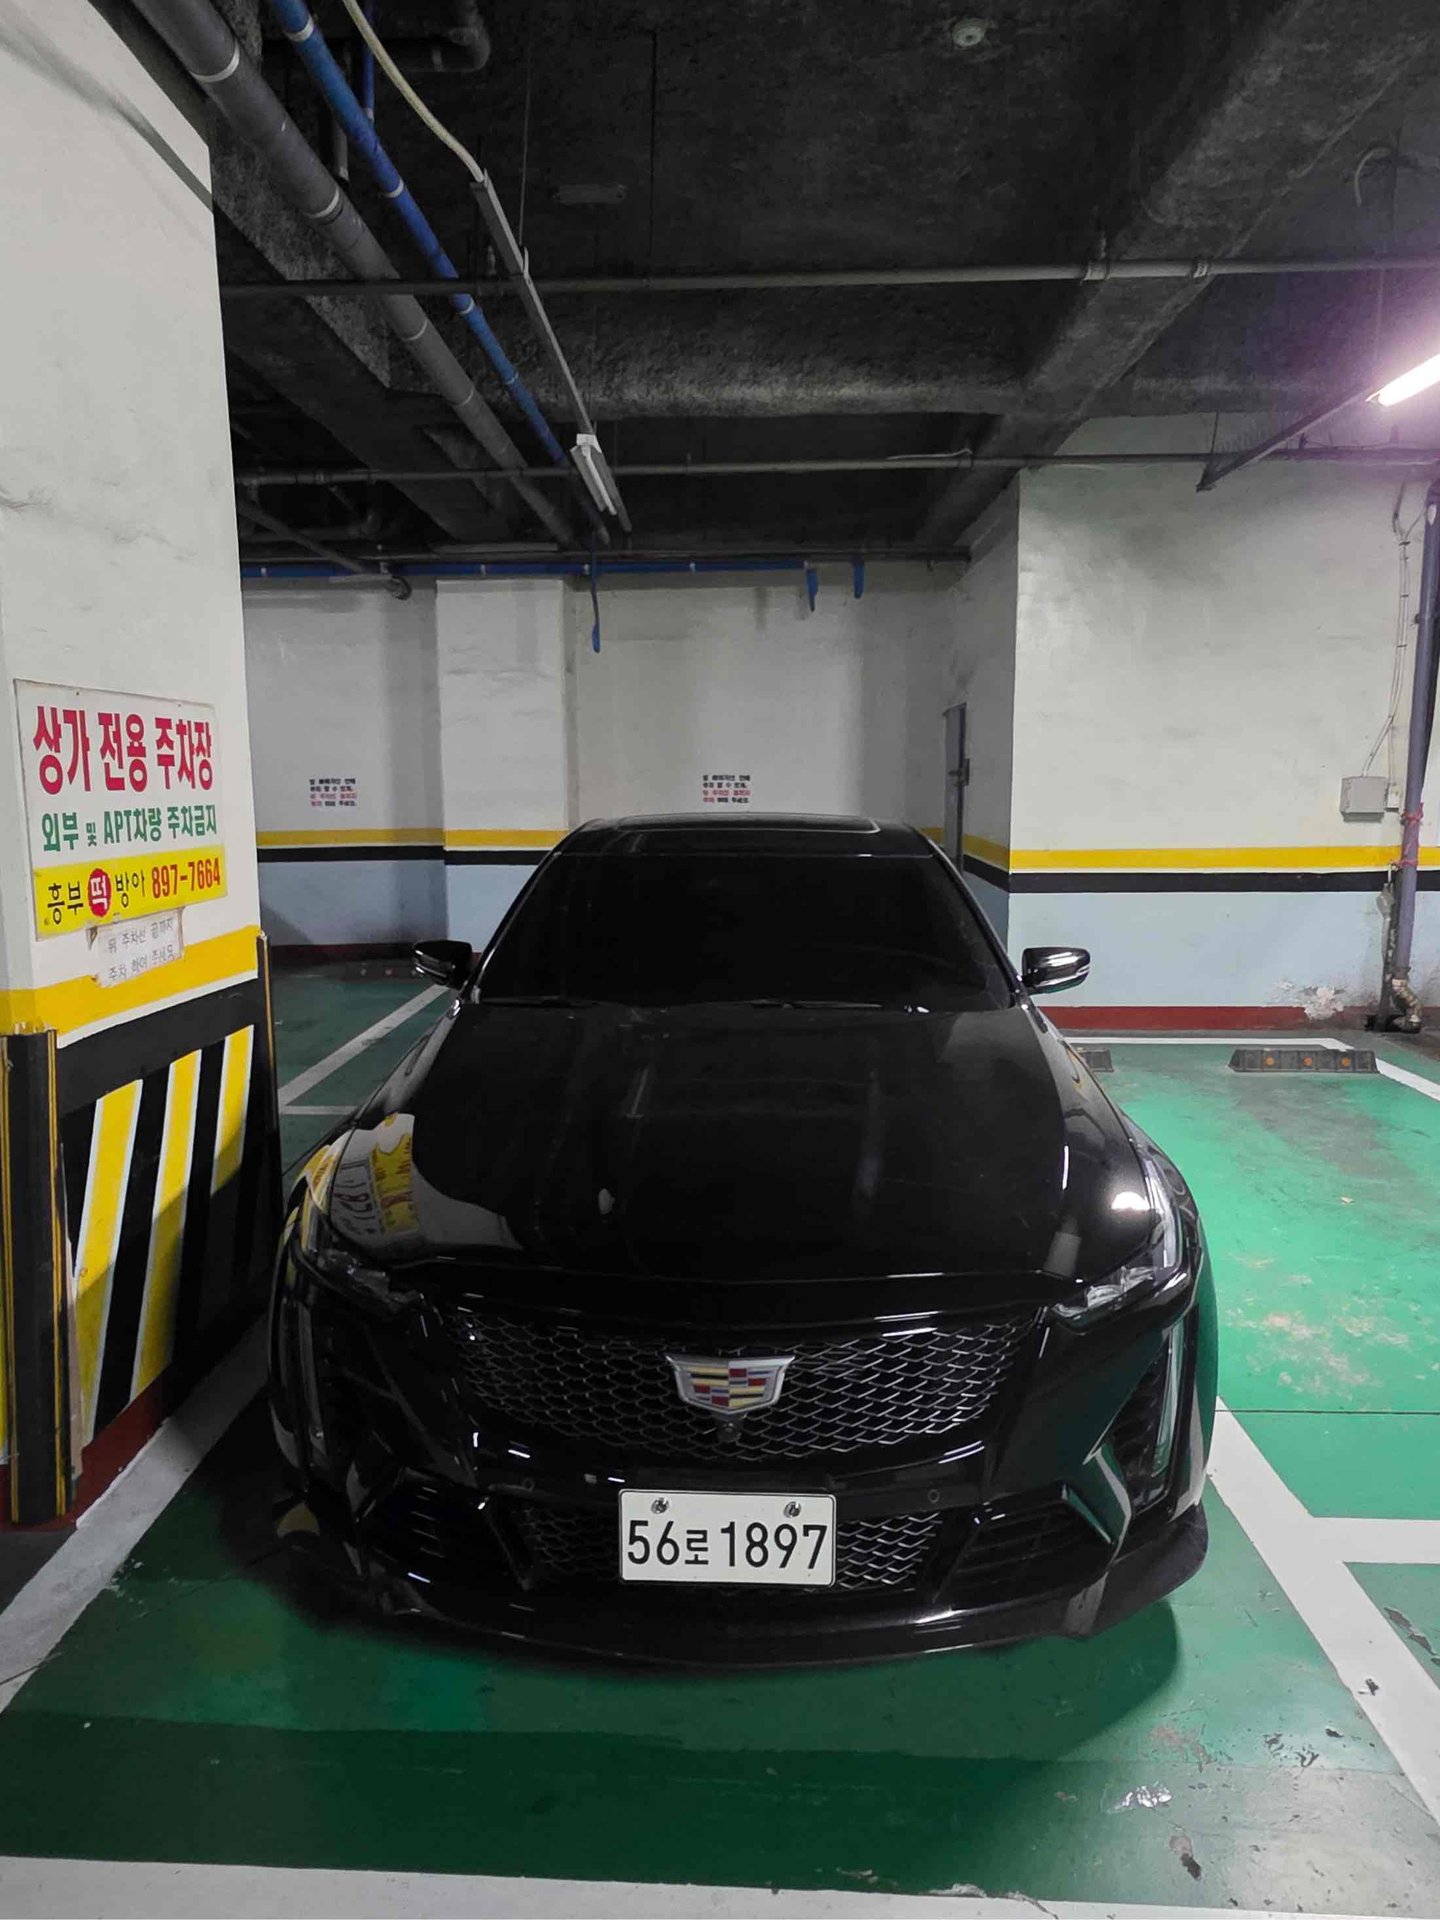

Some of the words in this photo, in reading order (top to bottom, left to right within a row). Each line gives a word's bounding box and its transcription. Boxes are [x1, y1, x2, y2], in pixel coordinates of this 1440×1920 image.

[33, 706, 91, 795] 상가
[98, 712, 147, 792] 전용
[155, 717, 213, 790] 주차장
[42, 812, 79, 851] 외부
[86, 822, 97, 847] 및
[104, 807, 162, 844] APT차량
[167, 804, 217, 839] 주차금지
[47, 880, 84, 925] 흥부
[90, 875, 108, 910] 떡
[115, 869, 146, 908] 방아
[151, 857, 221, 899] 897-7664
[109, 964, 127, 981] 주차
